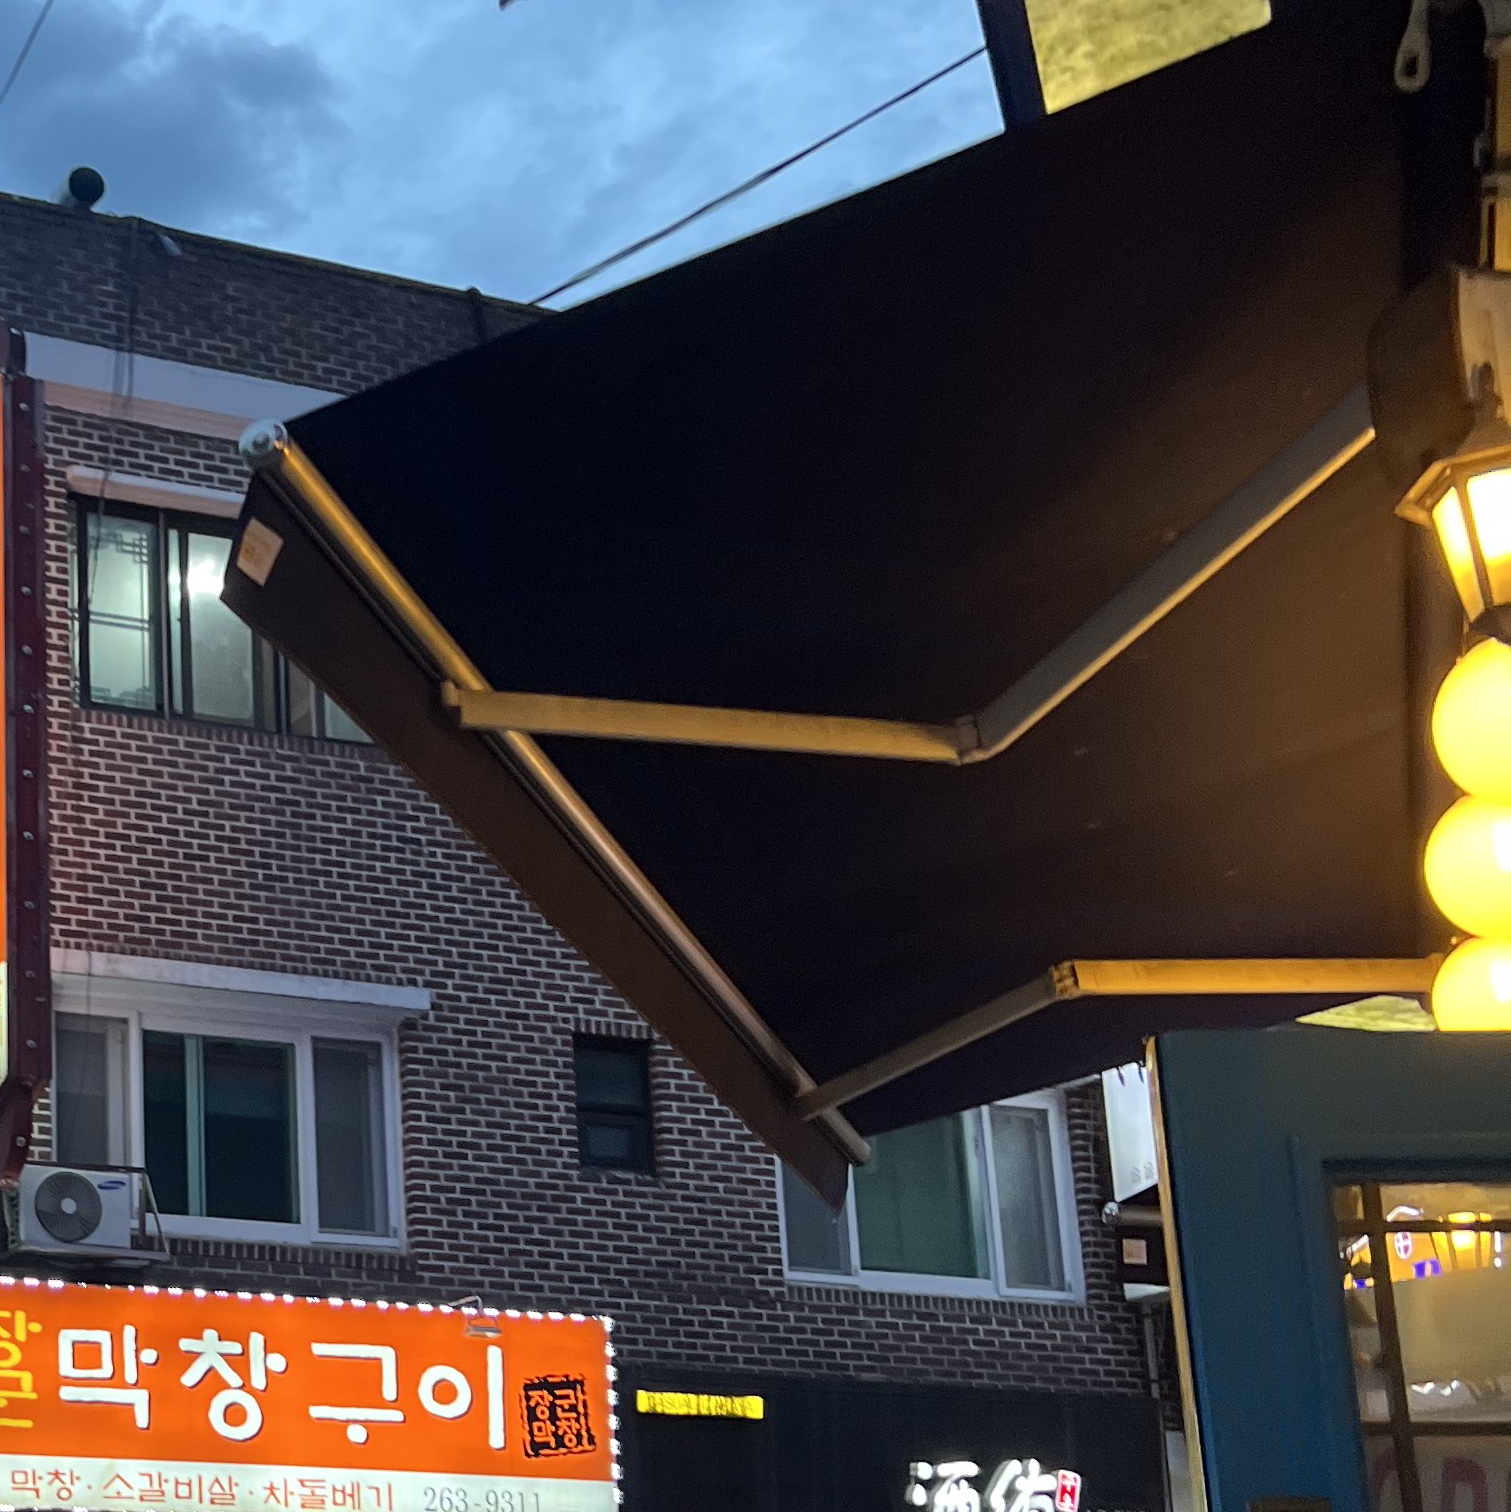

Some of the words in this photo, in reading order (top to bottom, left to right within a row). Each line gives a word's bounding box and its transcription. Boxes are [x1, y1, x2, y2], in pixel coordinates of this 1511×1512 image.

[57, 1323, 506, 1452] 막창구이
[526, 1388, 578, 1420] 장군
[532, 1419, 581, 1449] 막창
[9, 1468, 83, 1503] 막창
[101, 1472, 240, 1508] 소갈비살
[261, 1476, 395, 1512] 차돌베기
